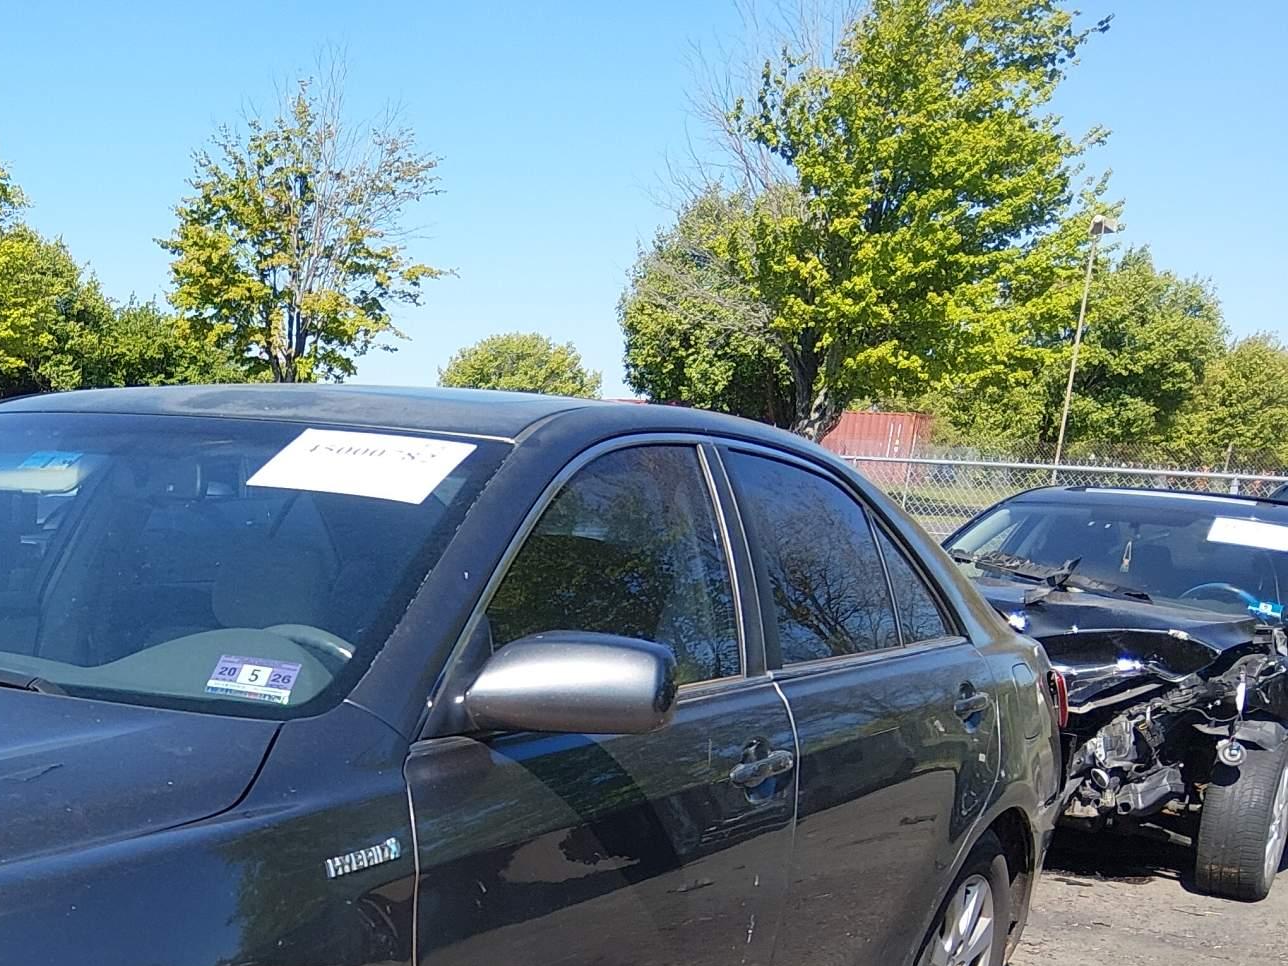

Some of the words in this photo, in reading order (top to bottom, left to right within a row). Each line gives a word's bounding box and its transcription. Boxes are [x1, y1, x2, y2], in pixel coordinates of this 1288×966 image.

[218, 666, 237, 677] 20
[248, 668, 261, 682] 5
[270, 673, 292, 684] 26
